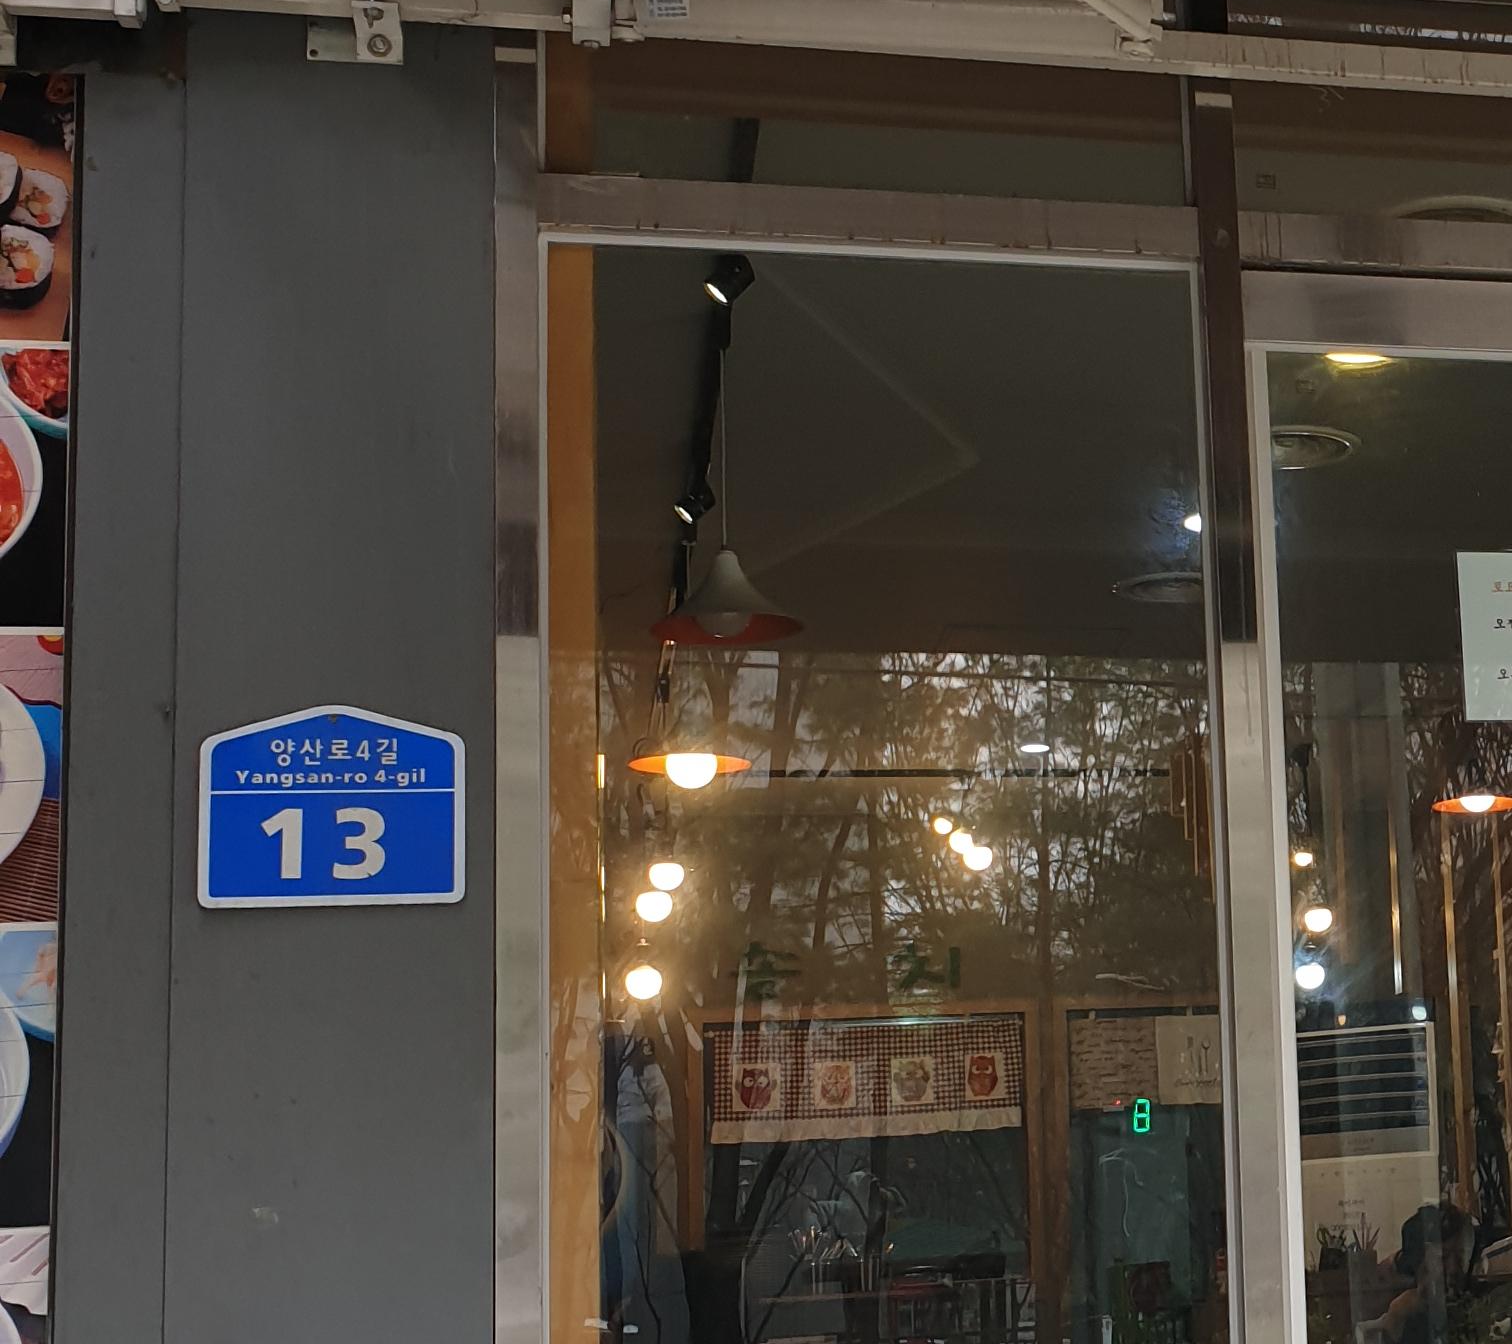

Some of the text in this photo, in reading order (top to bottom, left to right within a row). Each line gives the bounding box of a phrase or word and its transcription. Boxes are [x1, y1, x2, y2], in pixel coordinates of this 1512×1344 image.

[270, 738, 398, 767] 양산로4길
[236, 768, 426, 787] Yangsan-ro 4-gil
[260, 807, 386, 880] 13
